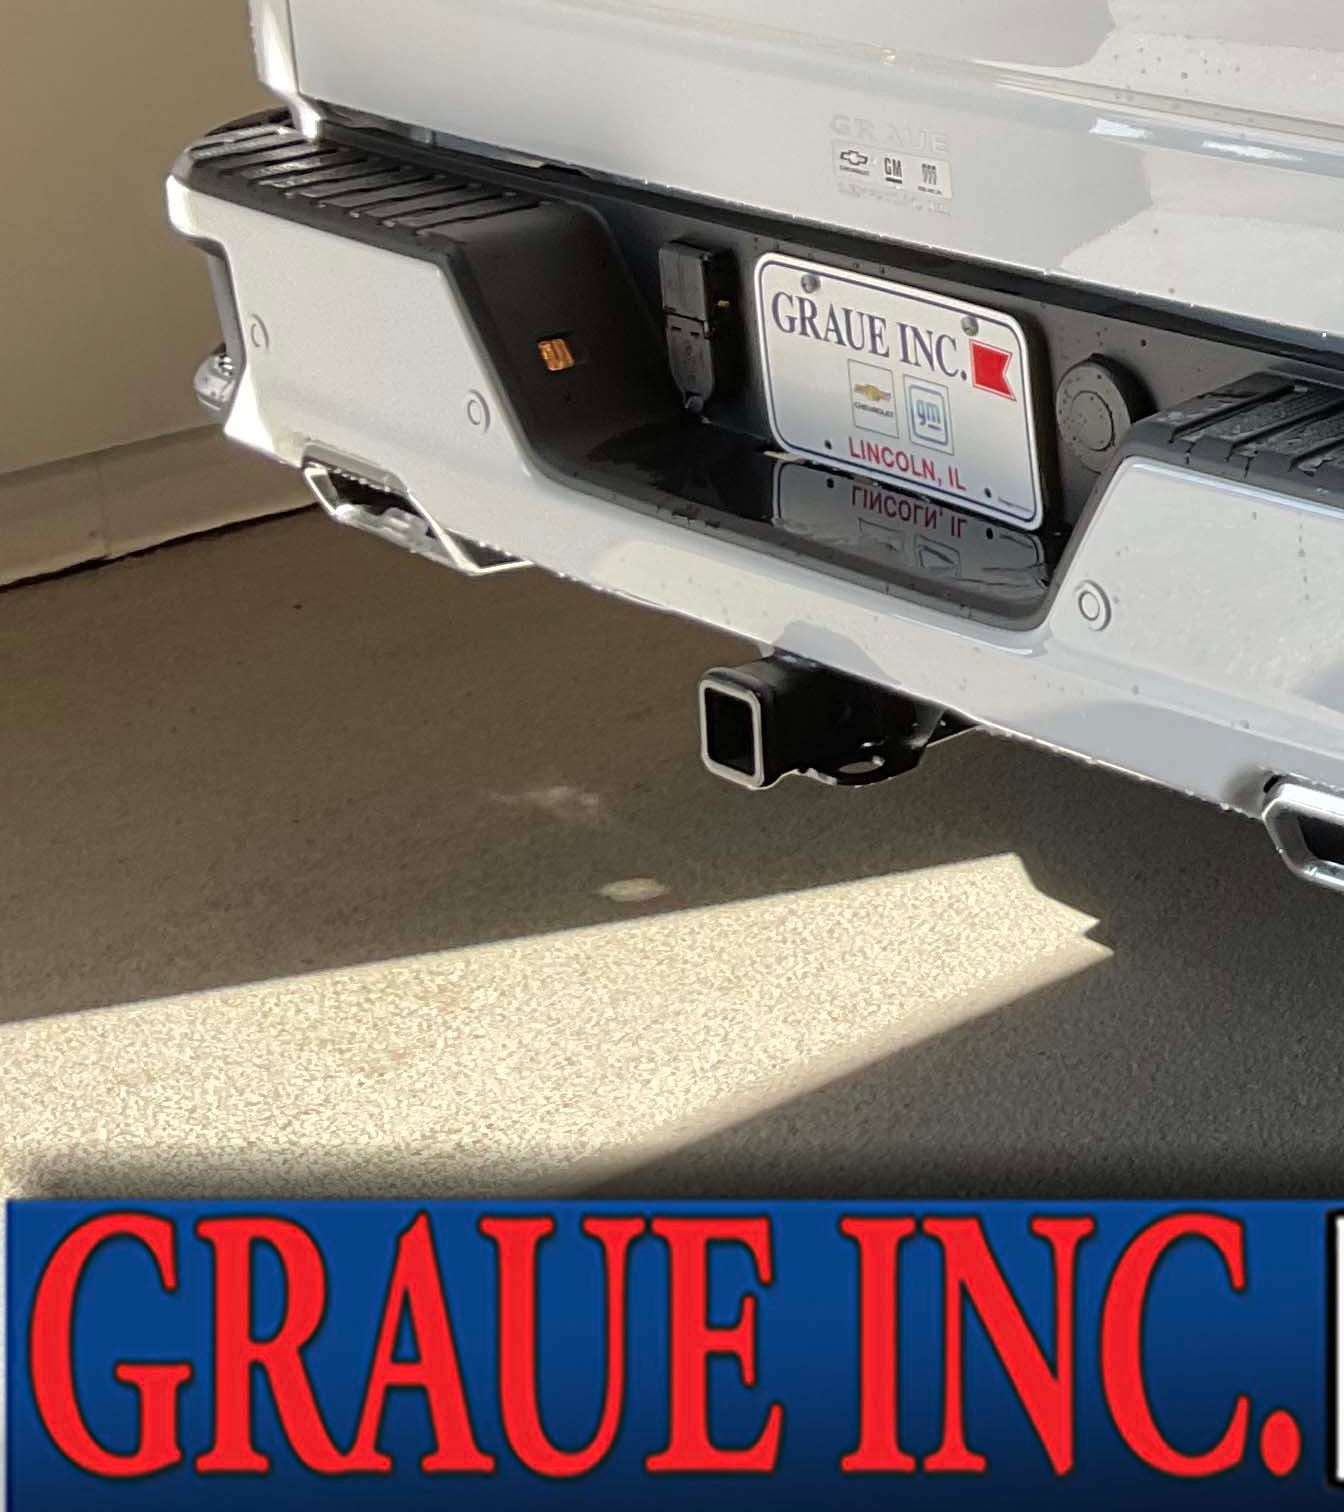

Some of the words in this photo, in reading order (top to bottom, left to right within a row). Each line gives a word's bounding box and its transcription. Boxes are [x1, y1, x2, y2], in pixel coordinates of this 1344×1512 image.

[771, 291, 890, 358] GRAUE
[896, 321, 968, 381] INC.
[848, 435, 943, 487] LINCOLN,
[948, 465, 967, 492] IL
